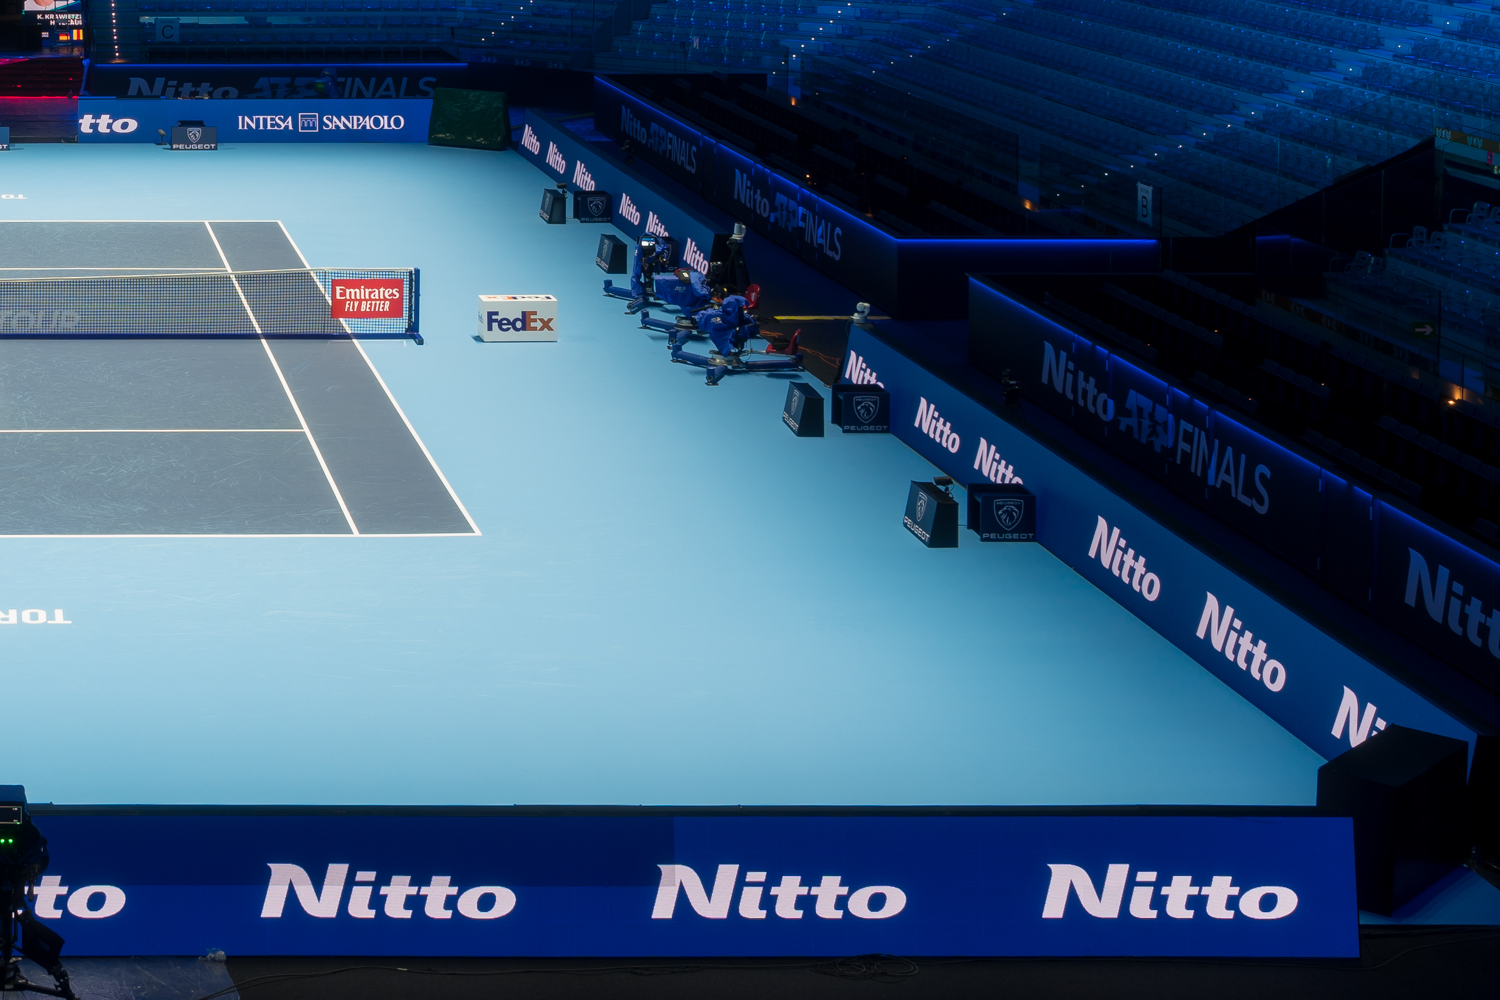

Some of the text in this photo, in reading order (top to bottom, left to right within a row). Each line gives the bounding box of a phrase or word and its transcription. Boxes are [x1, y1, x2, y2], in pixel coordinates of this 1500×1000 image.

[127, 77, 239, 99] Nitto
[237, 114, 405, 131] INTESA SANPAOLO
[521, 123, 541, 156] Nitto
[621, 105, 647, 145] Nitto
[667, 131, 697, 174] FINALS
[546, 140, 566, 175] Nitto
[572, 160, 596, 191] Nitto
[619, 192, 641, 226] Nitto
[733, 168, 770, 219] Nitto
[799, 205, 842, 262] FINALS
[683, 237, 709, 276] Nitto
[334, 285, 400, 301] Emirates
[344, 300, 391, 313] FLY BETTER
[487, 311, 554, 332] FedEx
[914, 396, 960, 454] Nitto
[1041, 340, 1114, 423] Nitto
[1176, 421, 1271, 515] FINALS
[904, 516, 930, 542] PEUGEOT
[1088, 514, 1160, 602] Nitto
[1196, 591, 1287, 693] Nitto
[260, 863, 517, 919] Nitto
[651, 863, 908, 920] Nitto
[1042, 863, 1299, 920] Nitto
